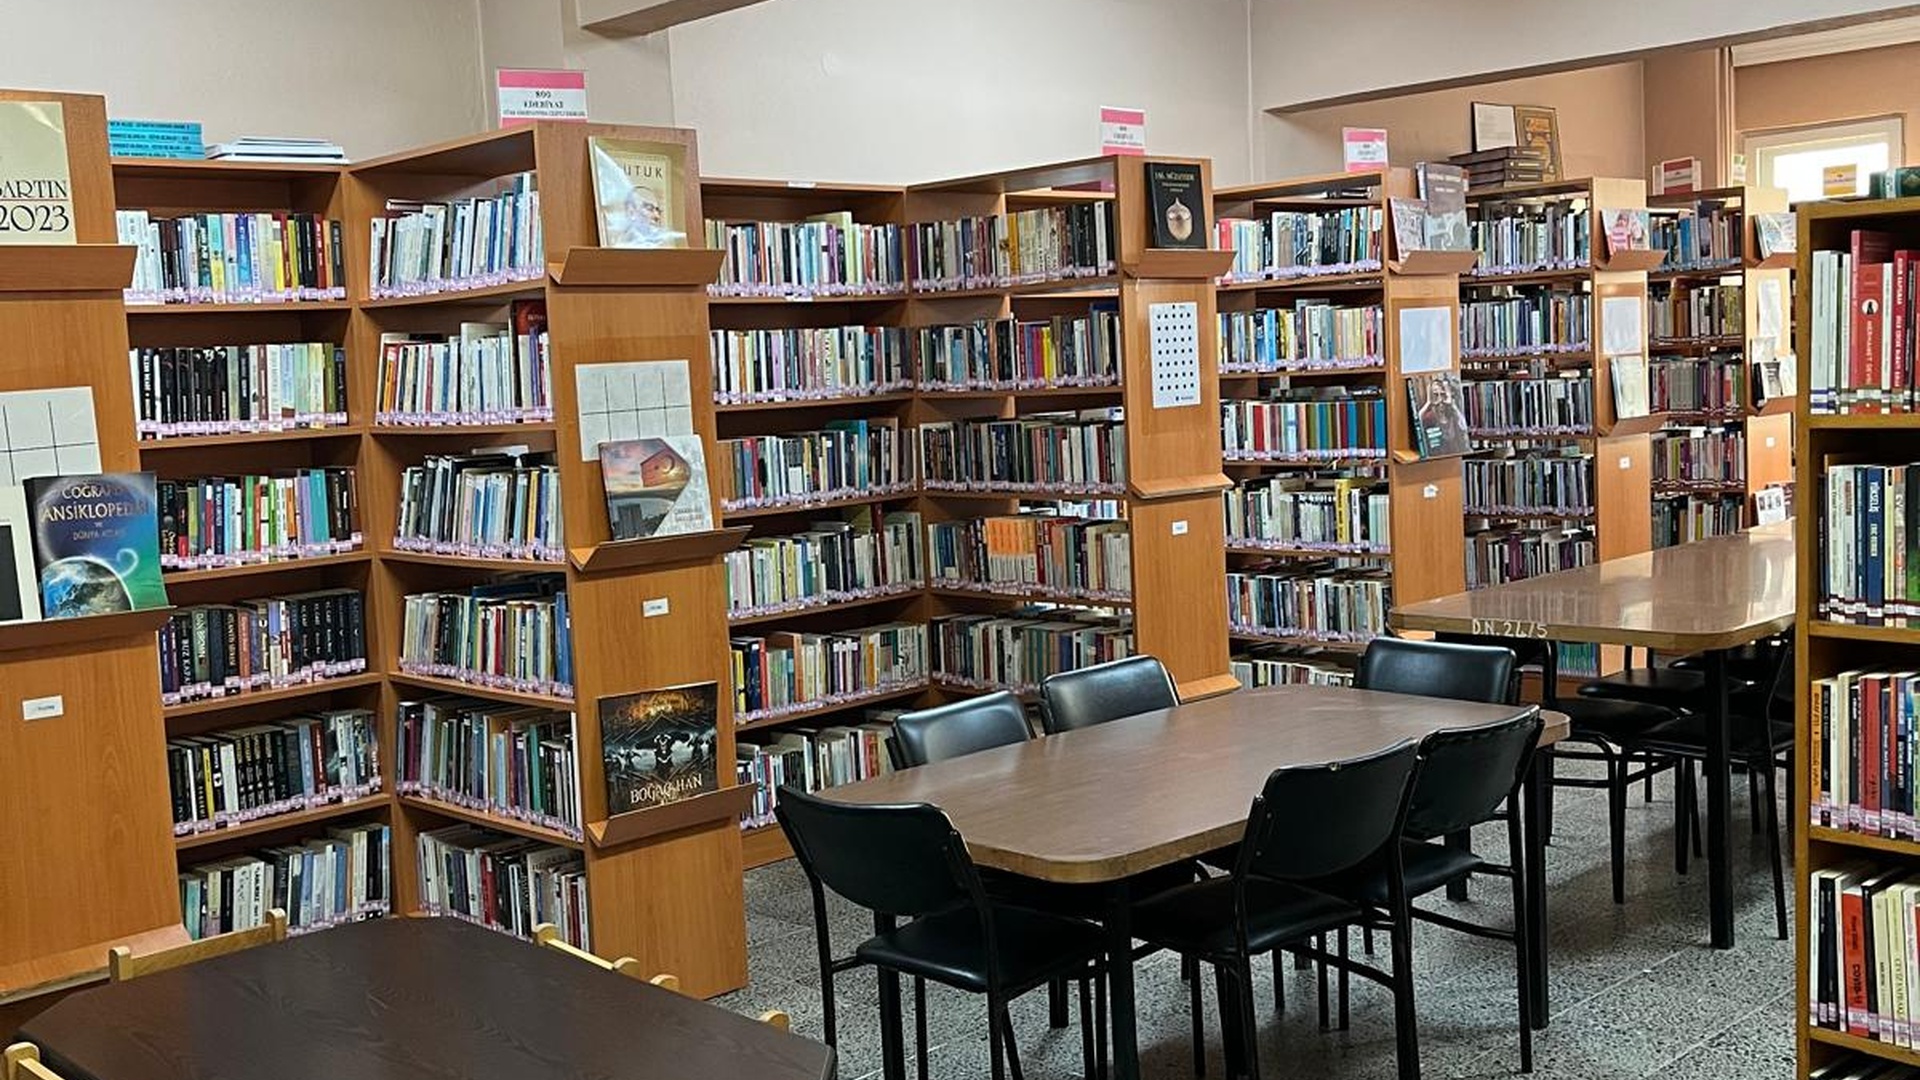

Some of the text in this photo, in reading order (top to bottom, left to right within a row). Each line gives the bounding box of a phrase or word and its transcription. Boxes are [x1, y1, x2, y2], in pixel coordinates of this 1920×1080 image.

[0, 180, 67, 198] ARTIN
[0, 204, 69, 232] 2023
[62, 482, 127, 500] COĞRA
[40, 500, 150, 522] ANSİKLOPEDSİ
[181, 658, 192, 687] KAPA
